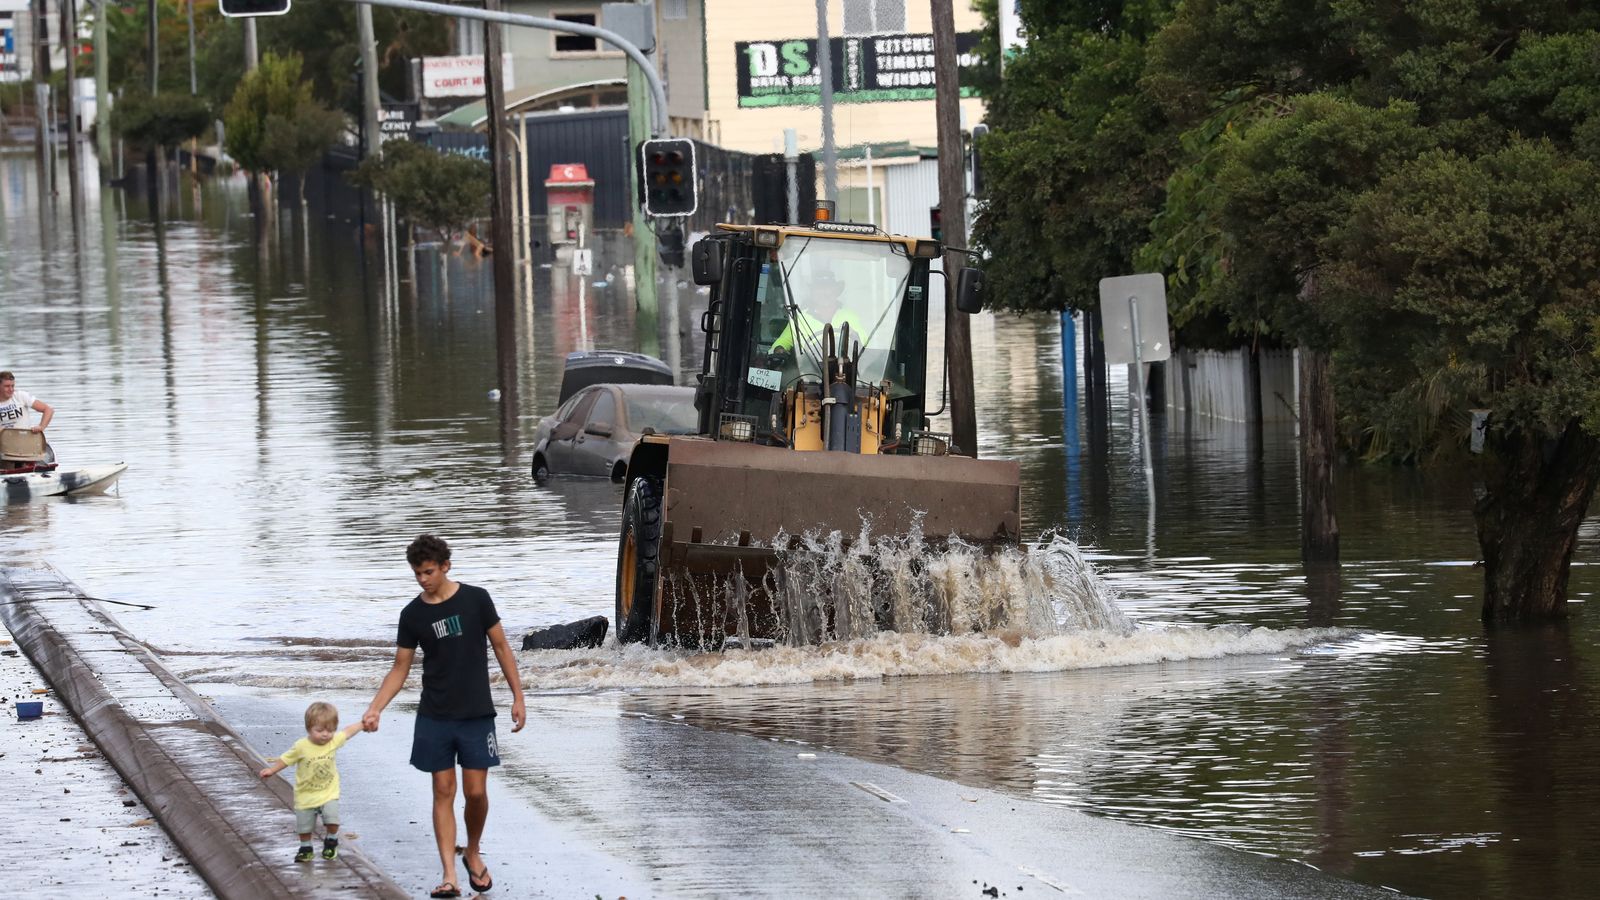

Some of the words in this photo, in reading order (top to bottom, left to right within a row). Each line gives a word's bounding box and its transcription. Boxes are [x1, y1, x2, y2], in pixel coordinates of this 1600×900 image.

[875, 37, 935, 53] KITCHE
[434, 78, 468, 88] COURT
[876, 71, 936, 87] WINDO
[381, 121, 412, 131] CKNEY
[0, 407, 23, 421] PEN
